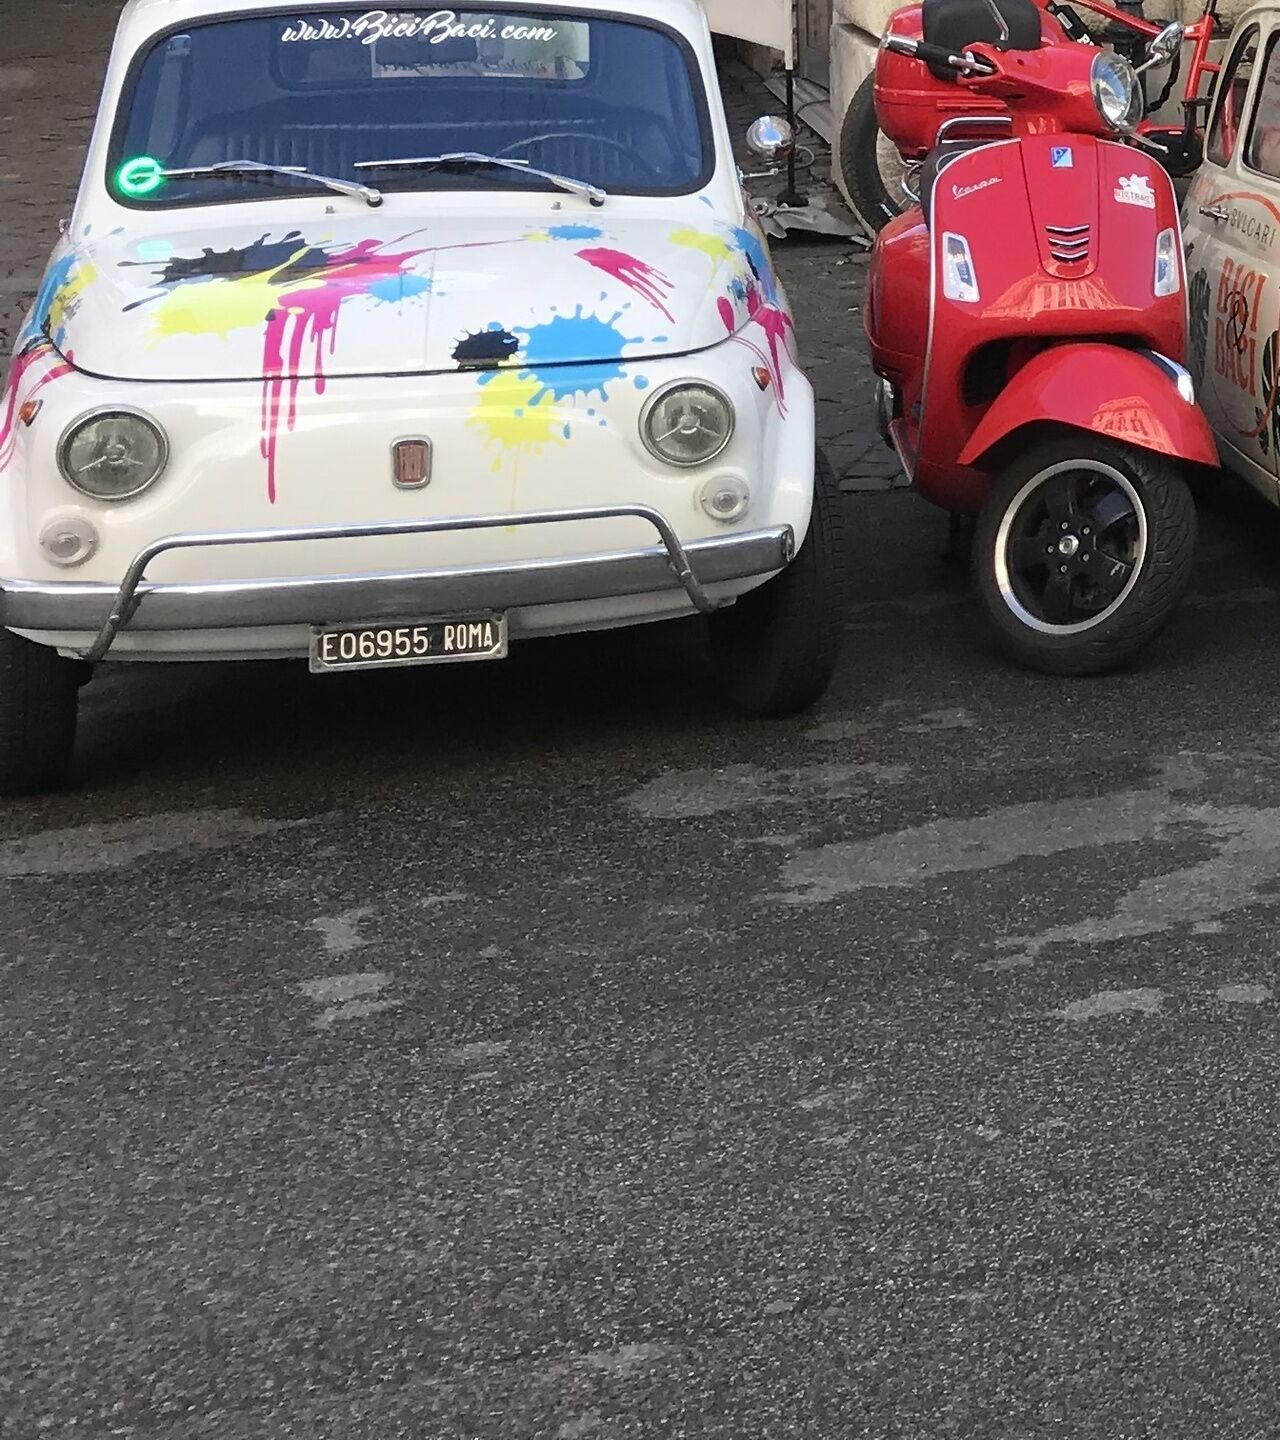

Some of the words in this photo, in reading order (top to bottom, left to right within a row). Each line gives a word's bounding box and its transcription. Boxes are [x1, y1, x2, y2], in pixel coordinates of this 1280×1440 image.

[281, 10, 557, 44] www.BiciBaci.com
[1216, 256, 1269, 332] BICI
[444, 622, 493, 651] ROMA
